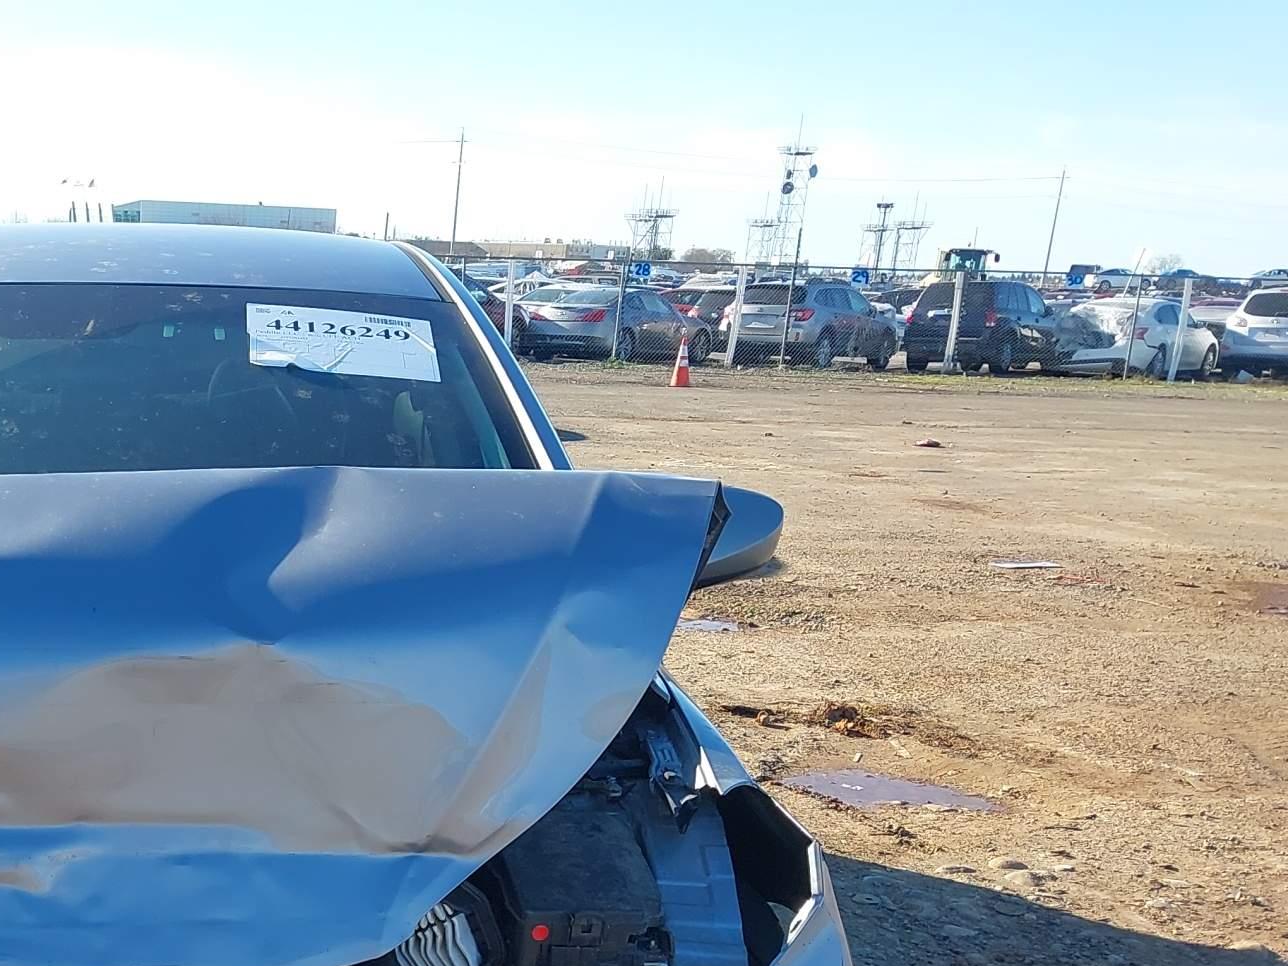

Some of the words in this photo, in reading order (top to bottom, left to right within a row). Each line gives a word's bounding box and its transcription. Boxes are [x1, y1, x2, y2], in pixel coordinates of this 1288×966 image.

[634, 263, 651, 276] 28
[852, 270, 869, 285] 29
[266, 318, 411, 341] 44126249
